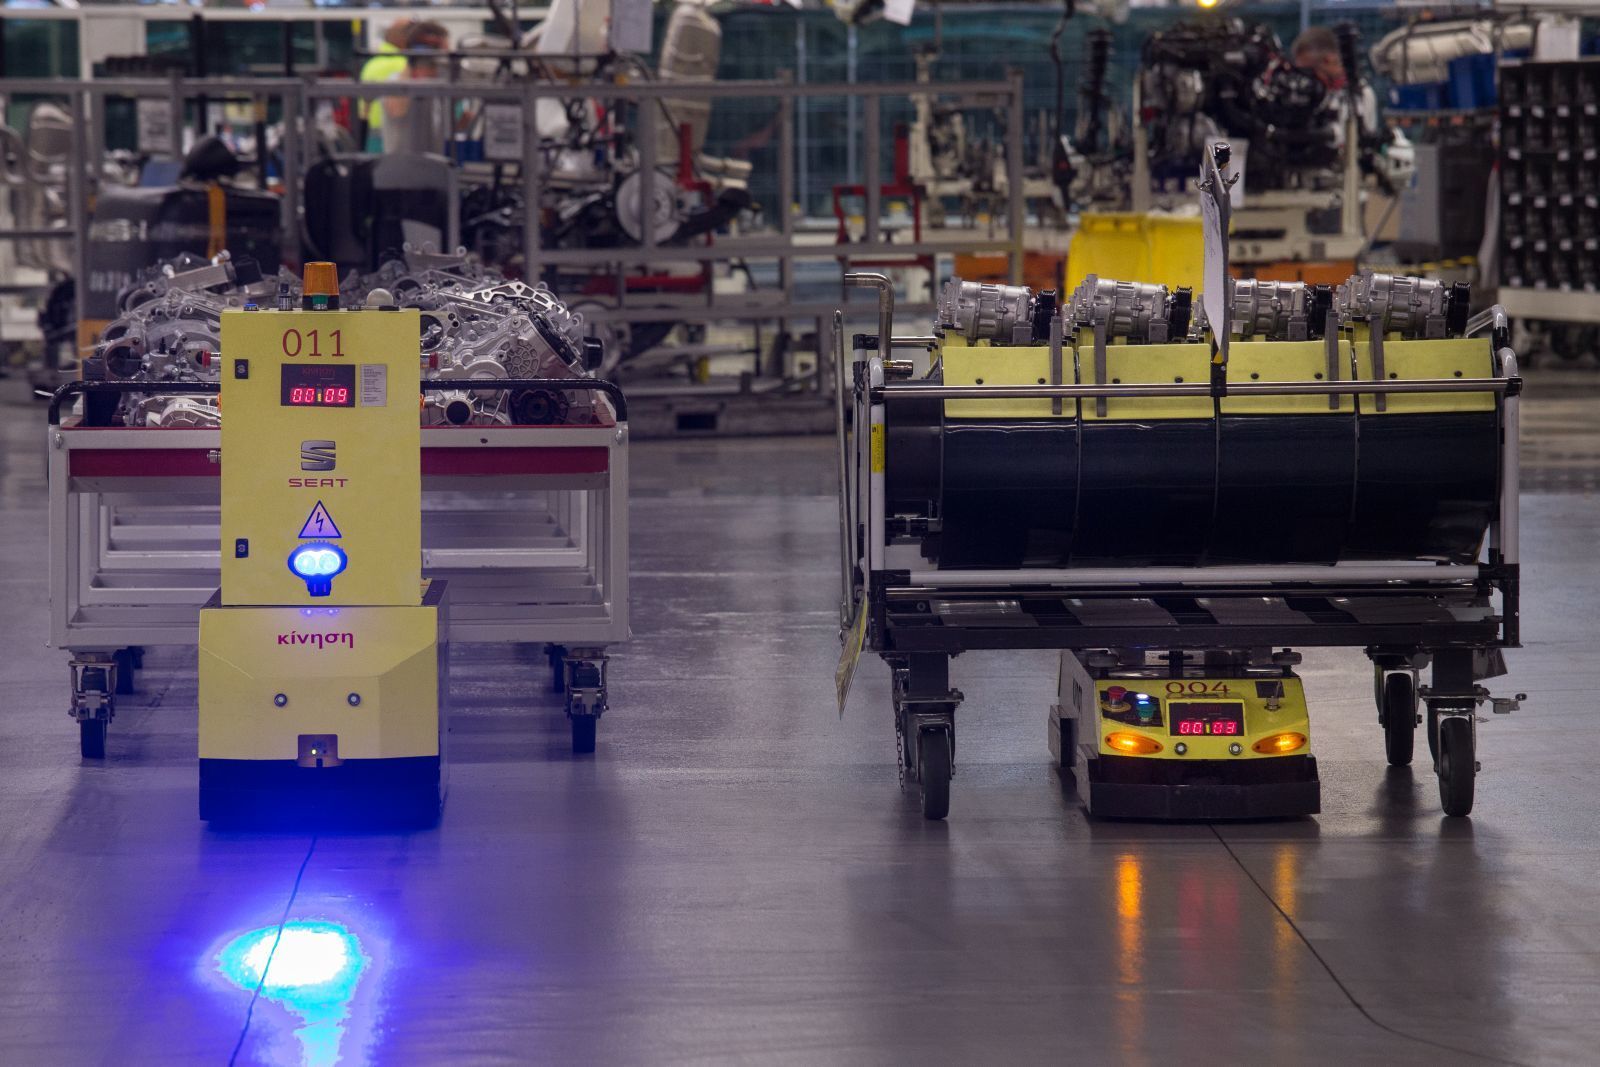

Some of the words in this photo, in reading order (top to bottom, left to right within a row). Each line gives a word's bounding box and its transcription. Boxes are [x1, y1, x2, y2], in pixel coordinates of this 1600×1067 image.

[282, 328, 345, 357] 011
[292, 388, 315, 402] 00
[324, 388, 347, 402] 09
[288, 478, 348, 488] SEAT
[277, 630, 354, 650] κίνηση
[1165, 681, 1230, 694] 004
[1179, 721, 1202, 734] 00
[1212, 721, 1236, 734] 03
